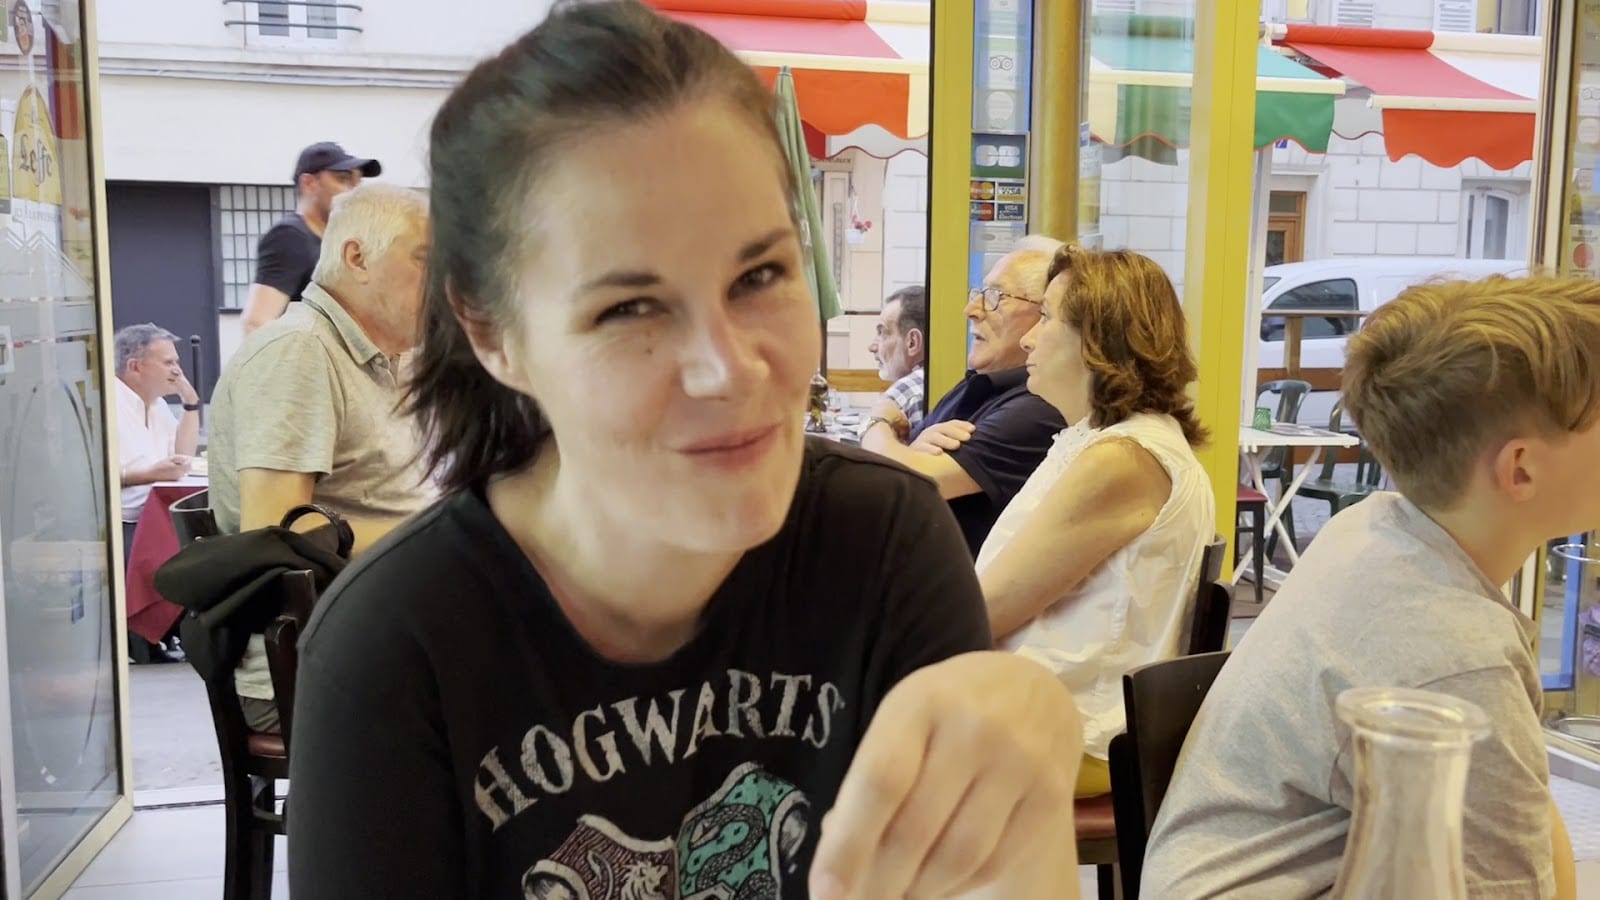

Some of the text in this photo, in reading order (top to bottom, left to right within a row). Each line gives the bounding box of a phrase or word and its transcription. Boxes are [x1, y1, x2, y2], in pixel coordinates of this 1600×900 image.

[18, 133, 53, 188] Leffe
[1000, 187, 1021, 195] VISA
[474, 668, 846, 833] HOGWARTS
